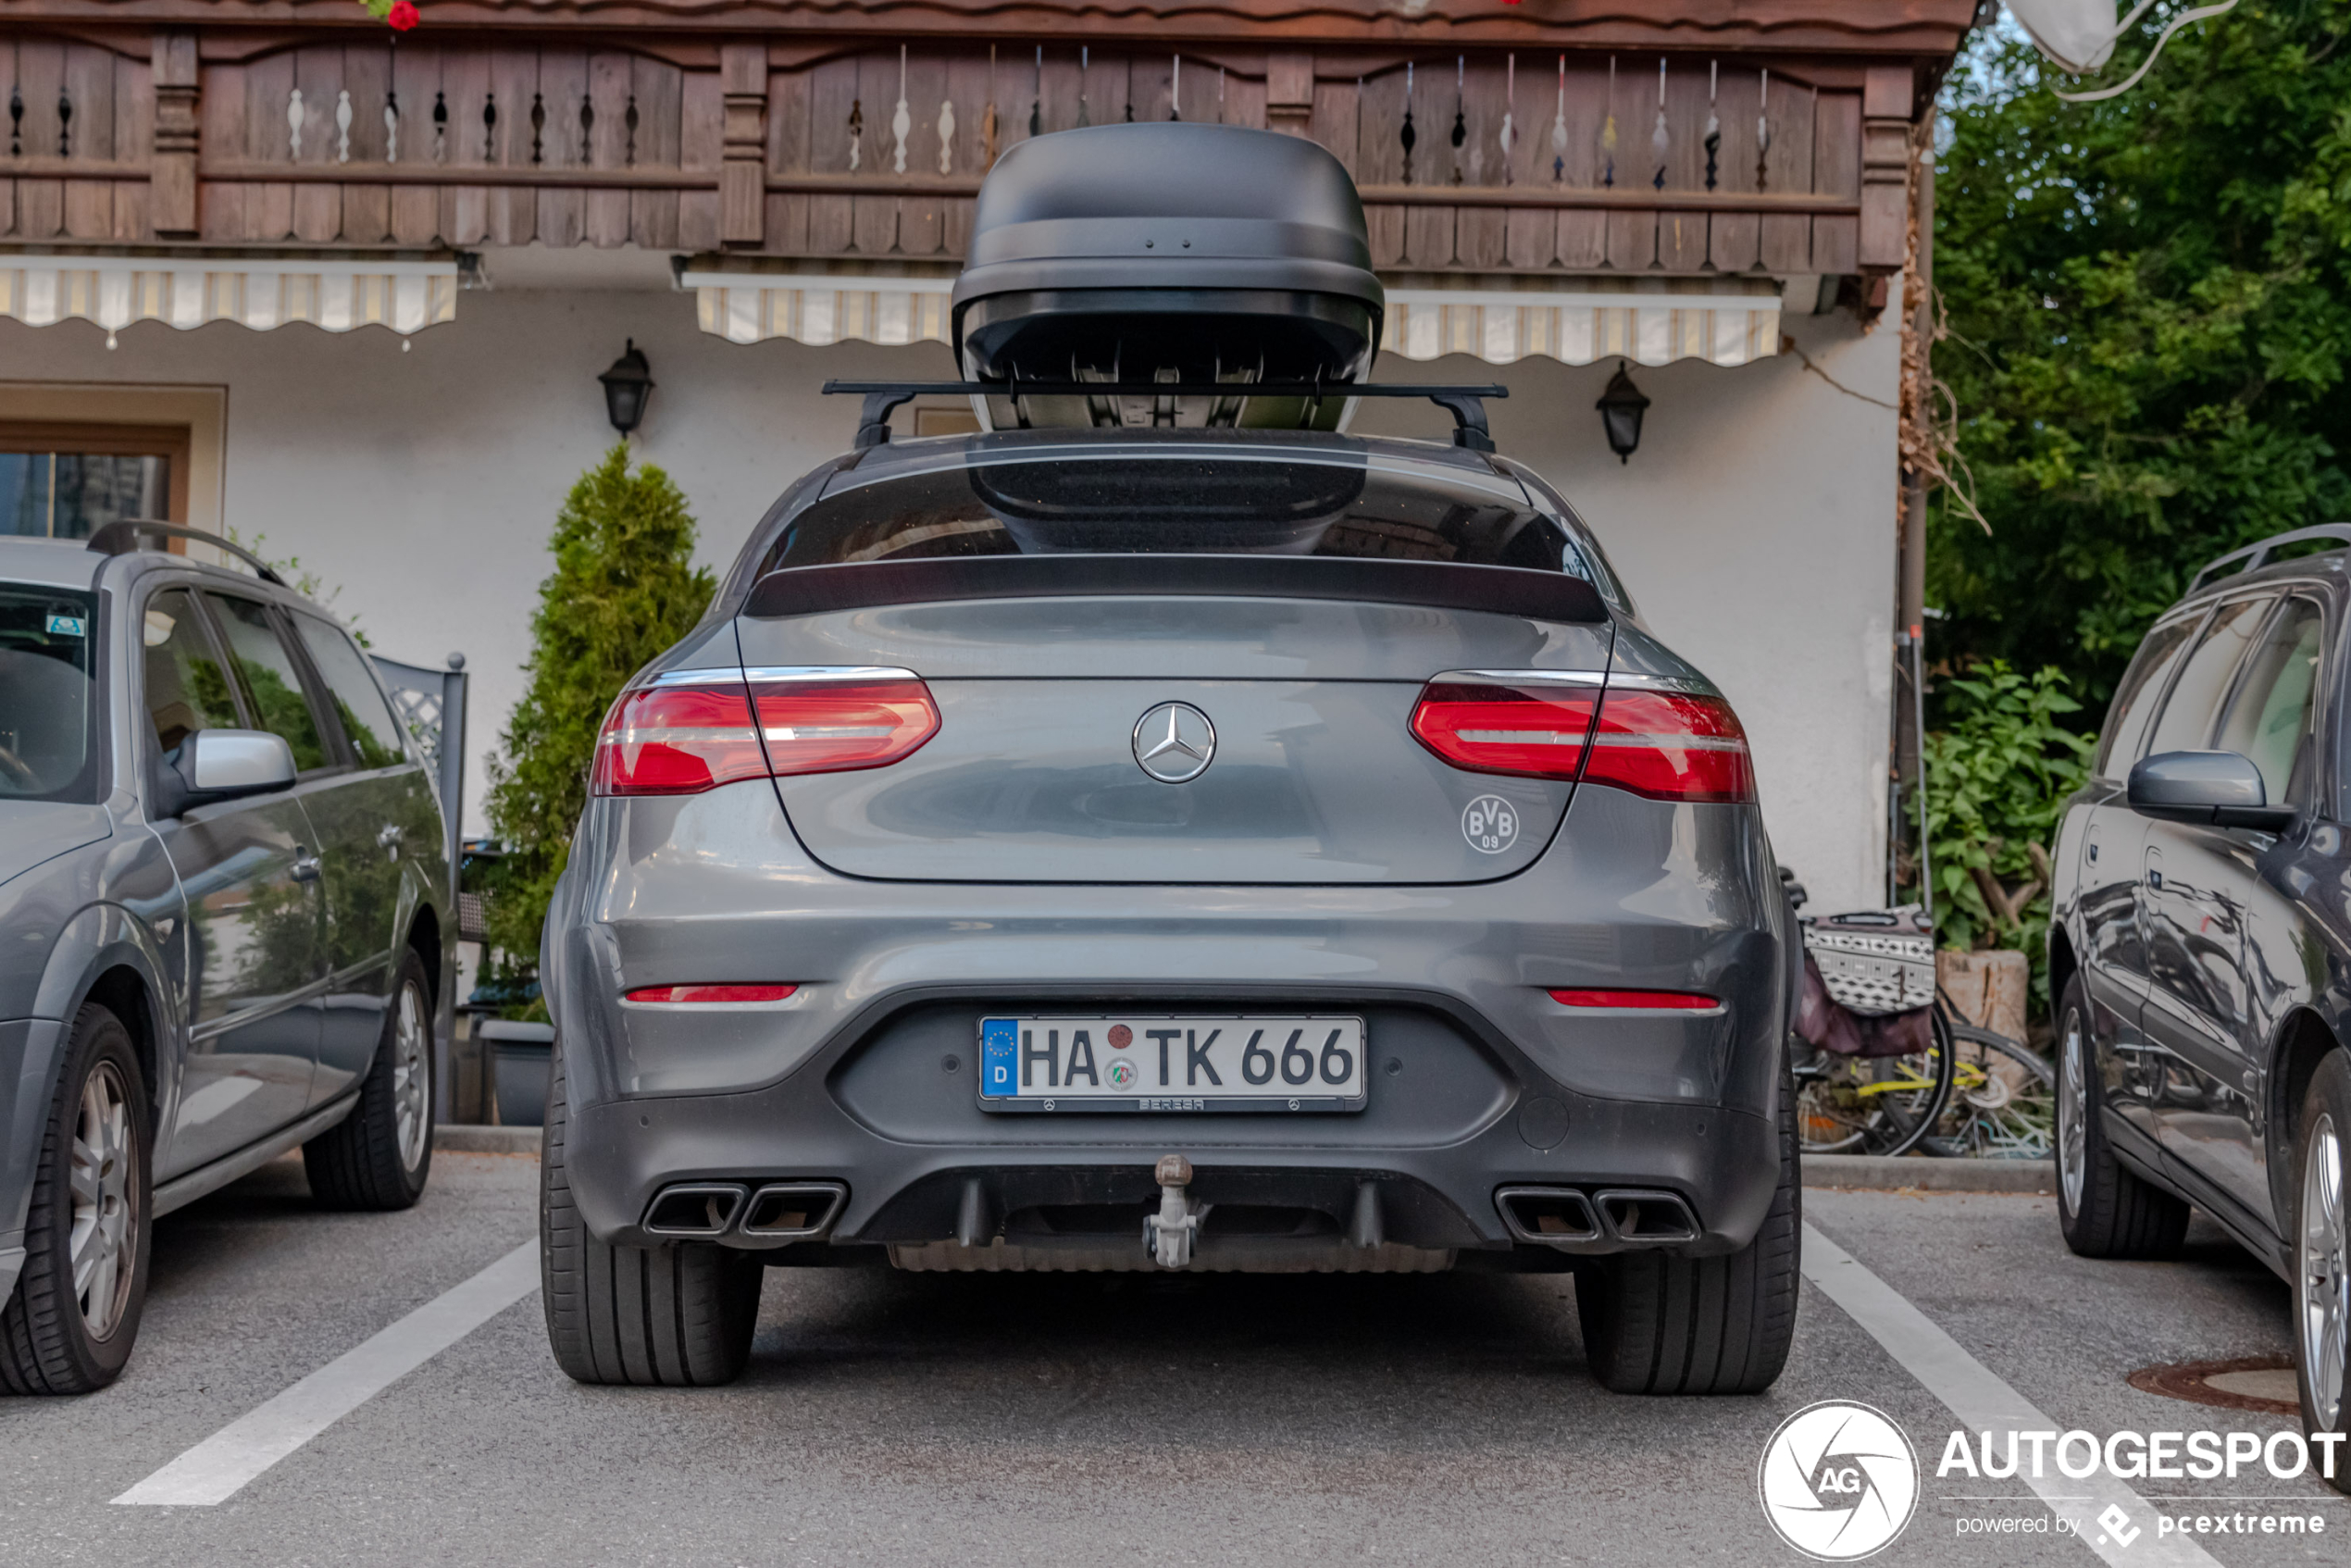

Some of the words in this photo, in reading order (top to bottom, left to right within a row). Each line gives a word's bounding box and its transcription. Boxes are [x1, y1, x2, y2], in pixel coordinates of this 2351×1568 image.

[1469, 800, 1513, 837] BVB
[1482, 834, 1499, 849] 09
[1022, 1029, 1099, 1087] HA
[1146, 1028, 1223, 1087] TK
[1241, 1028, 1353, 1086] 666
[994, 1066, 1007, 1083] D
[1139, 1099, 1204, 1111] BERESA
